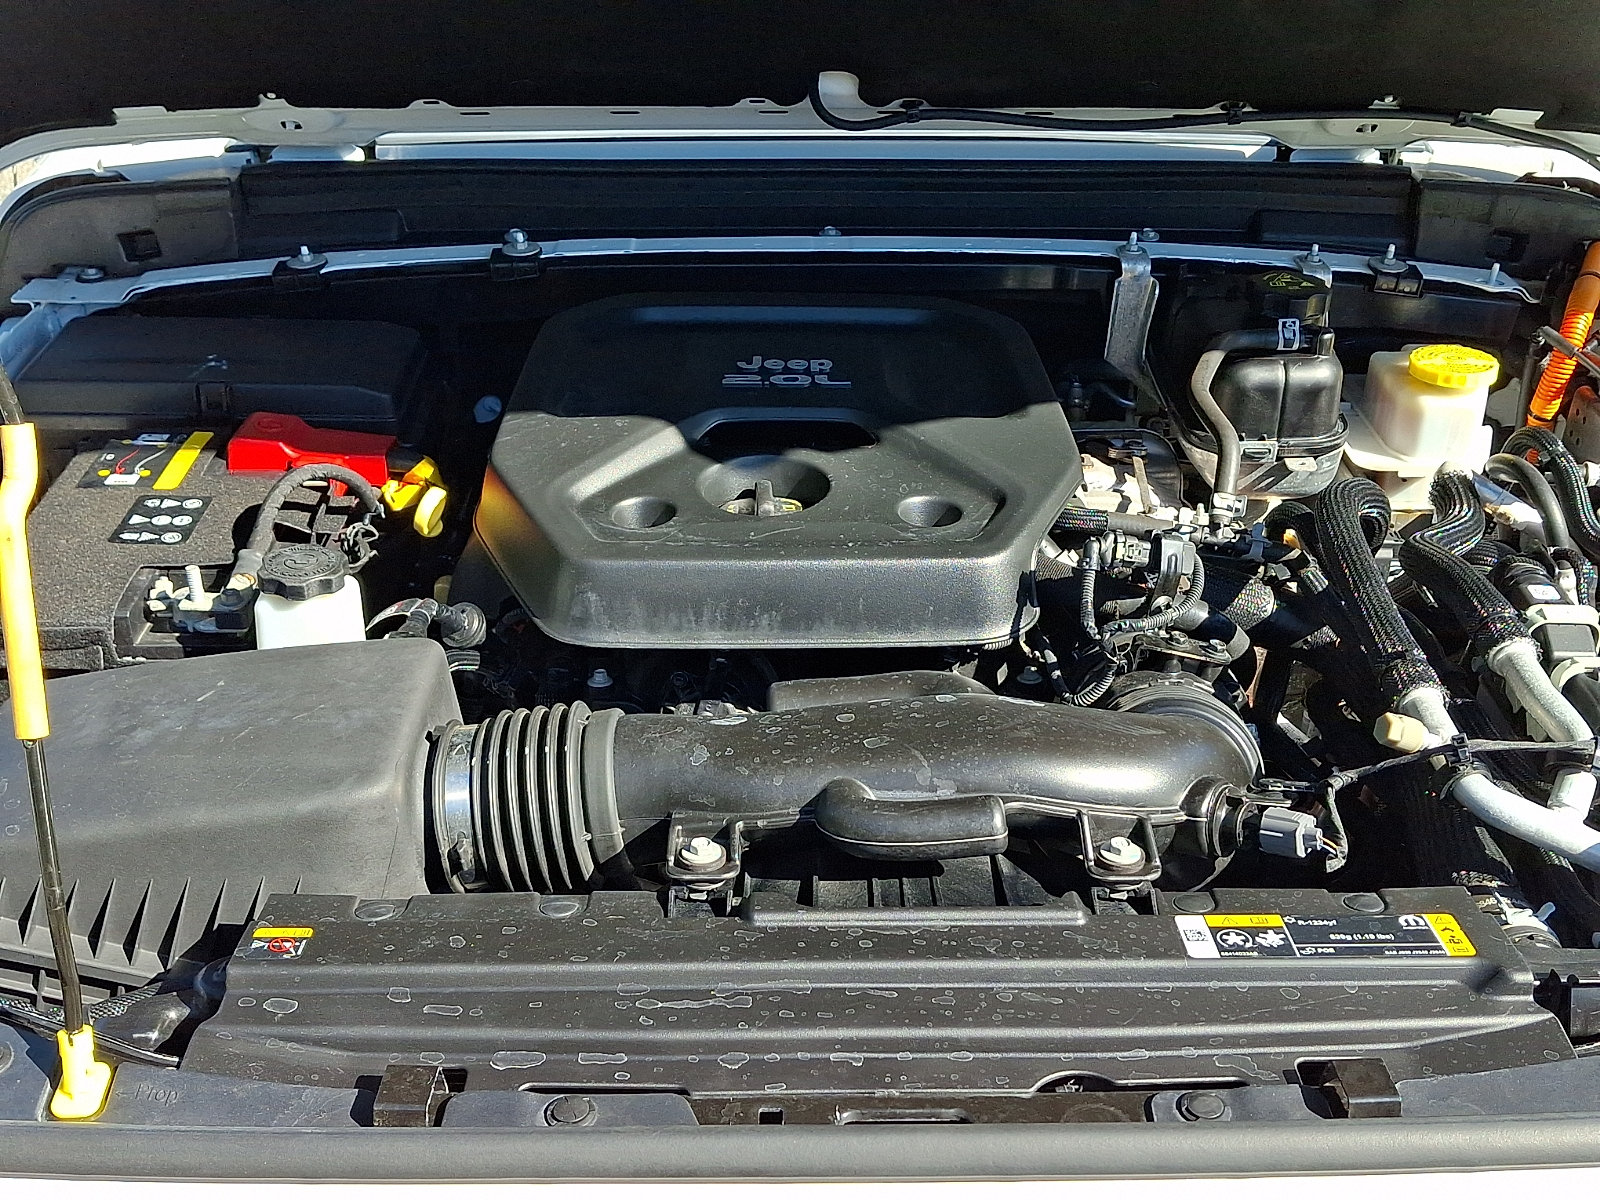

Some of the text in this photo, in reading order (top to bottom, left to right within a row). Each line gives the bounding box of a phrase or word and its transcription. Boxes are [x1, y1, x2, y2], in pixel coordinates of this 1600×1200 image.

[736, 355, 834, 373] Jeep
[722, 374, 852, 389] 2.0L
[134, 1083, 179, 1107] Prop
